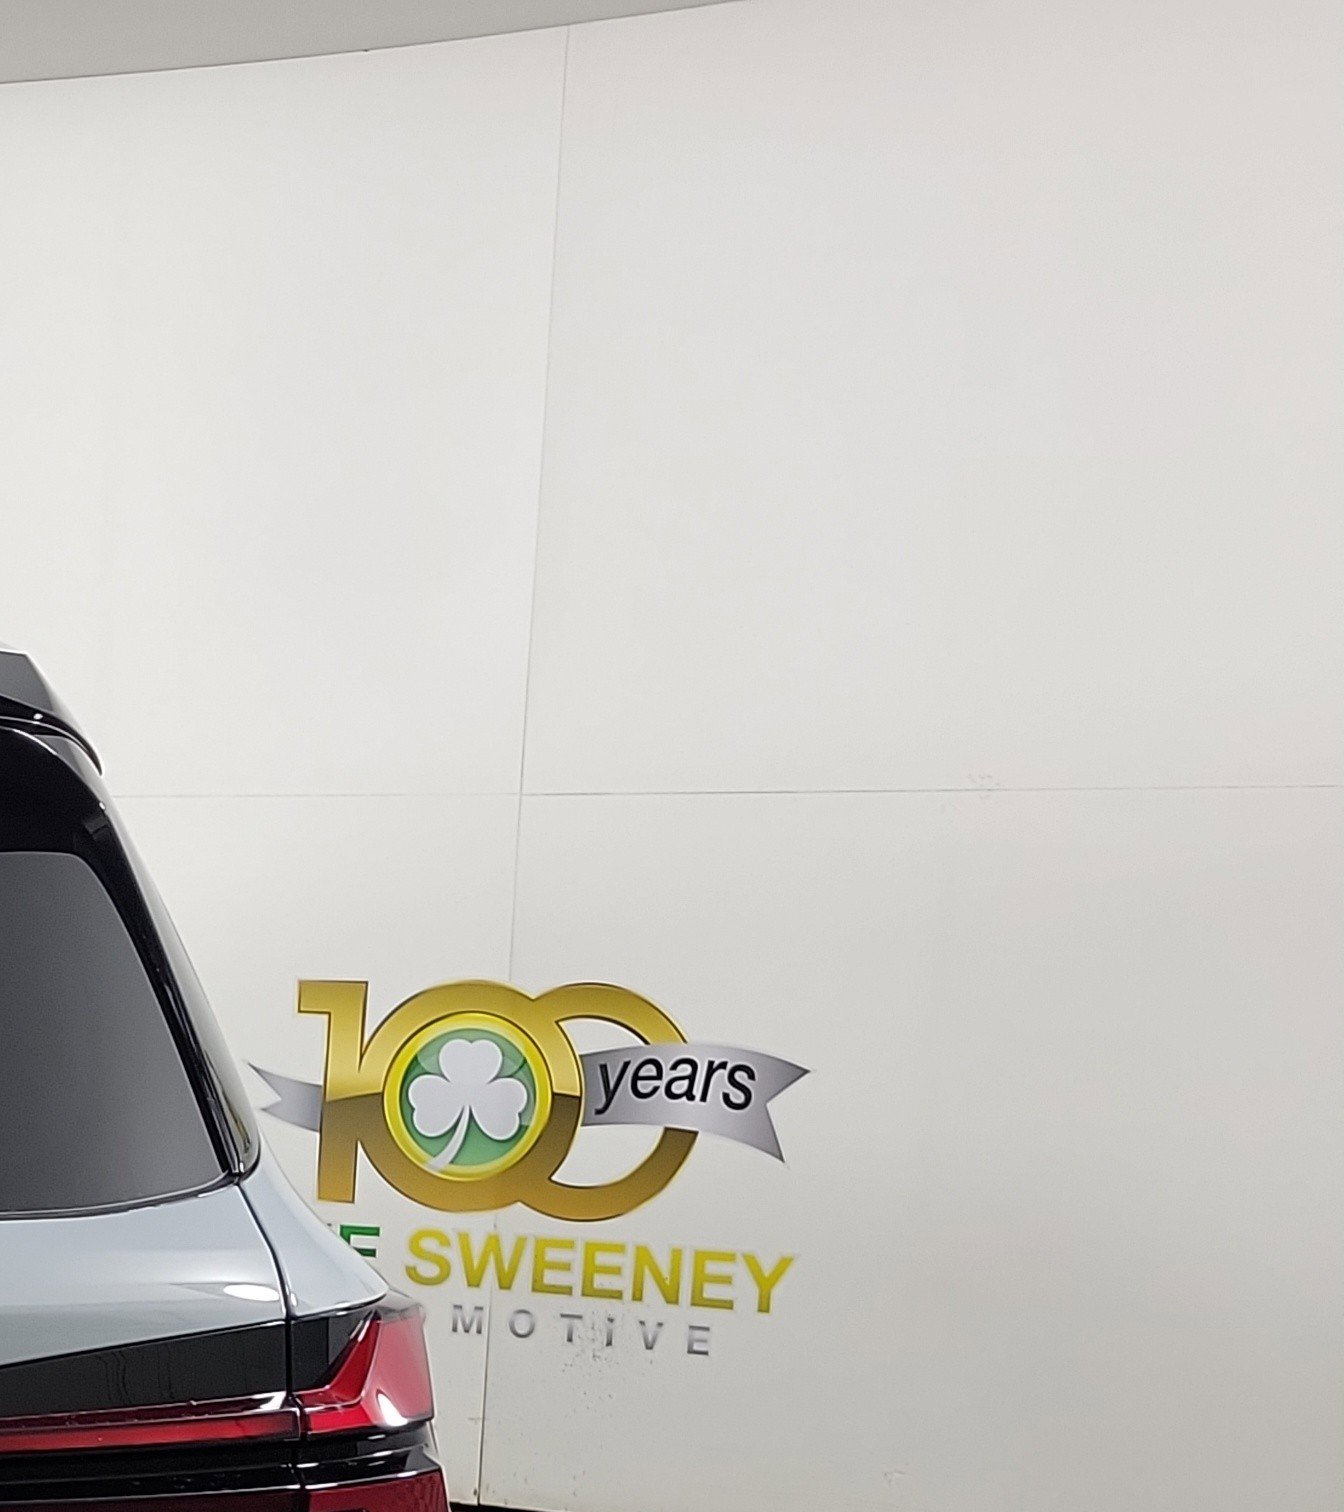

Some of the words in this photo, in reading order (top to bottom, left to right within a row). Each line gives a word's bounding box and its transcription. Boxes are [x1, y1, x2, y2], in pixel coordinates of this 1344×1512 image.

[297, 979, 698, 1222] 100
[594, 1055, 756, 1116] years
[404, 1229, 794, 1313] SWEENEY
[451, 1304, 711, 1356] MOTIVE
